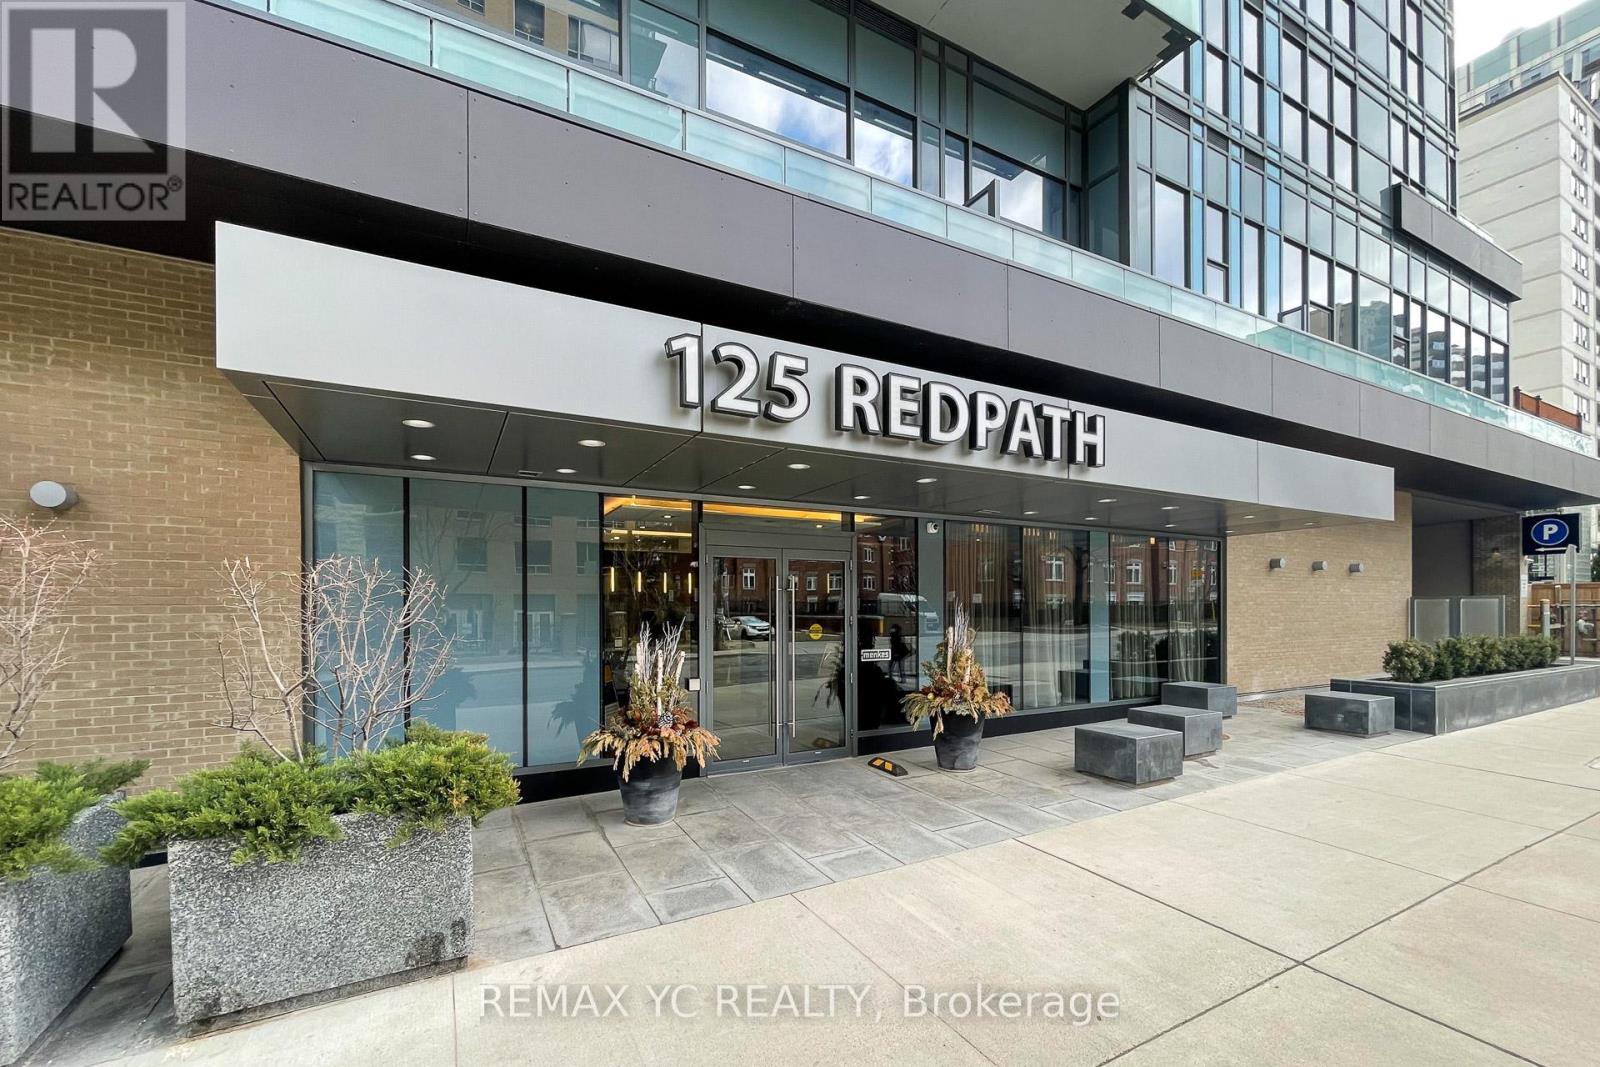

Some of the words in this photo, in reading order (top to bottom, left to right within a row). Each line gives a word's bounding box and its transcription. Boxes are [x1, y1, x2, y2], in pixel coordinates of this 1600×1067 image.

[664, 333, 811, 423] 125
[835, 363, 1106, 468] REDPATH
[1543, 524, 1558, 540] P
[863, 651, 889, 659] menkes
